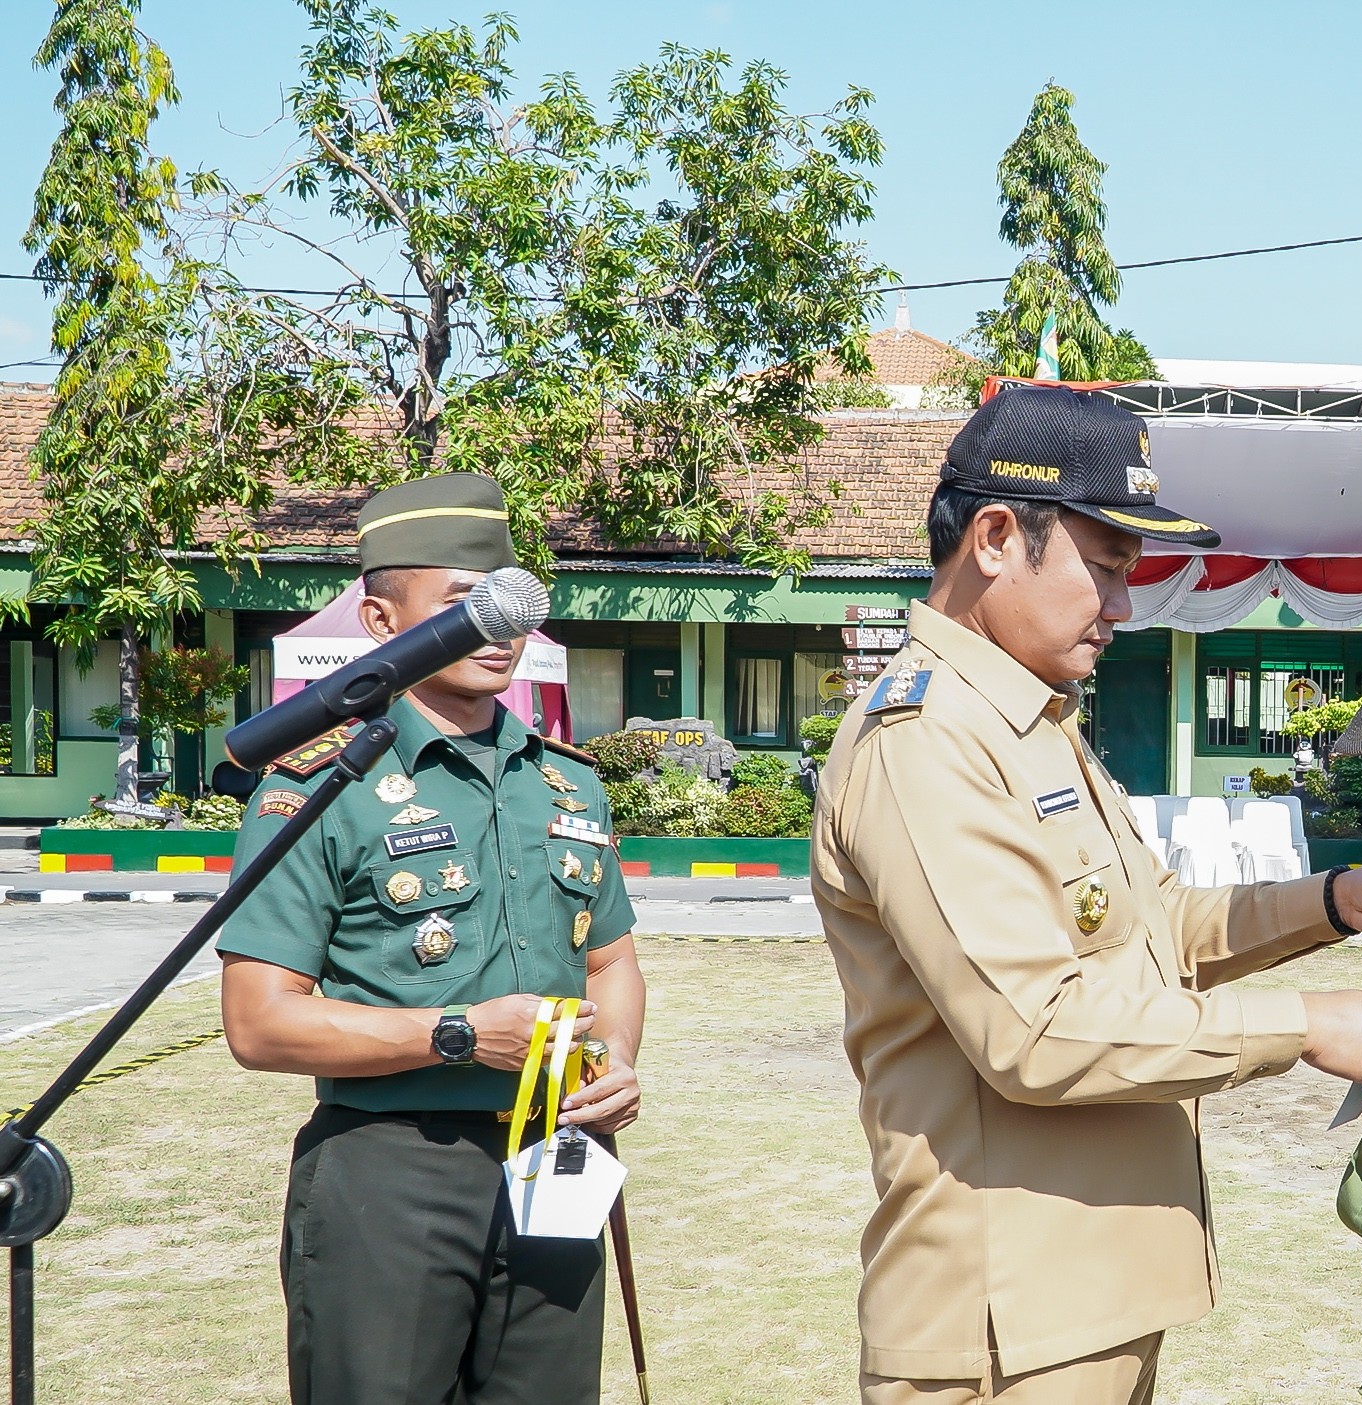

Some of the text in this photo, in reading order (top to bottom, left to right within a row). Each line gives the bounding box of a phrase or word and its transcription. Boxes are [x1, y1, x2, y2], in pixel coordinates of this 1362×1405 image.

[990, 459, 1060, 483] YUHRONUR
[857, 607, 899, 619] SUMPAH
[675, 731, 704, 746] OPS
[395, 831, 449, 848] KETUT WIRA P
